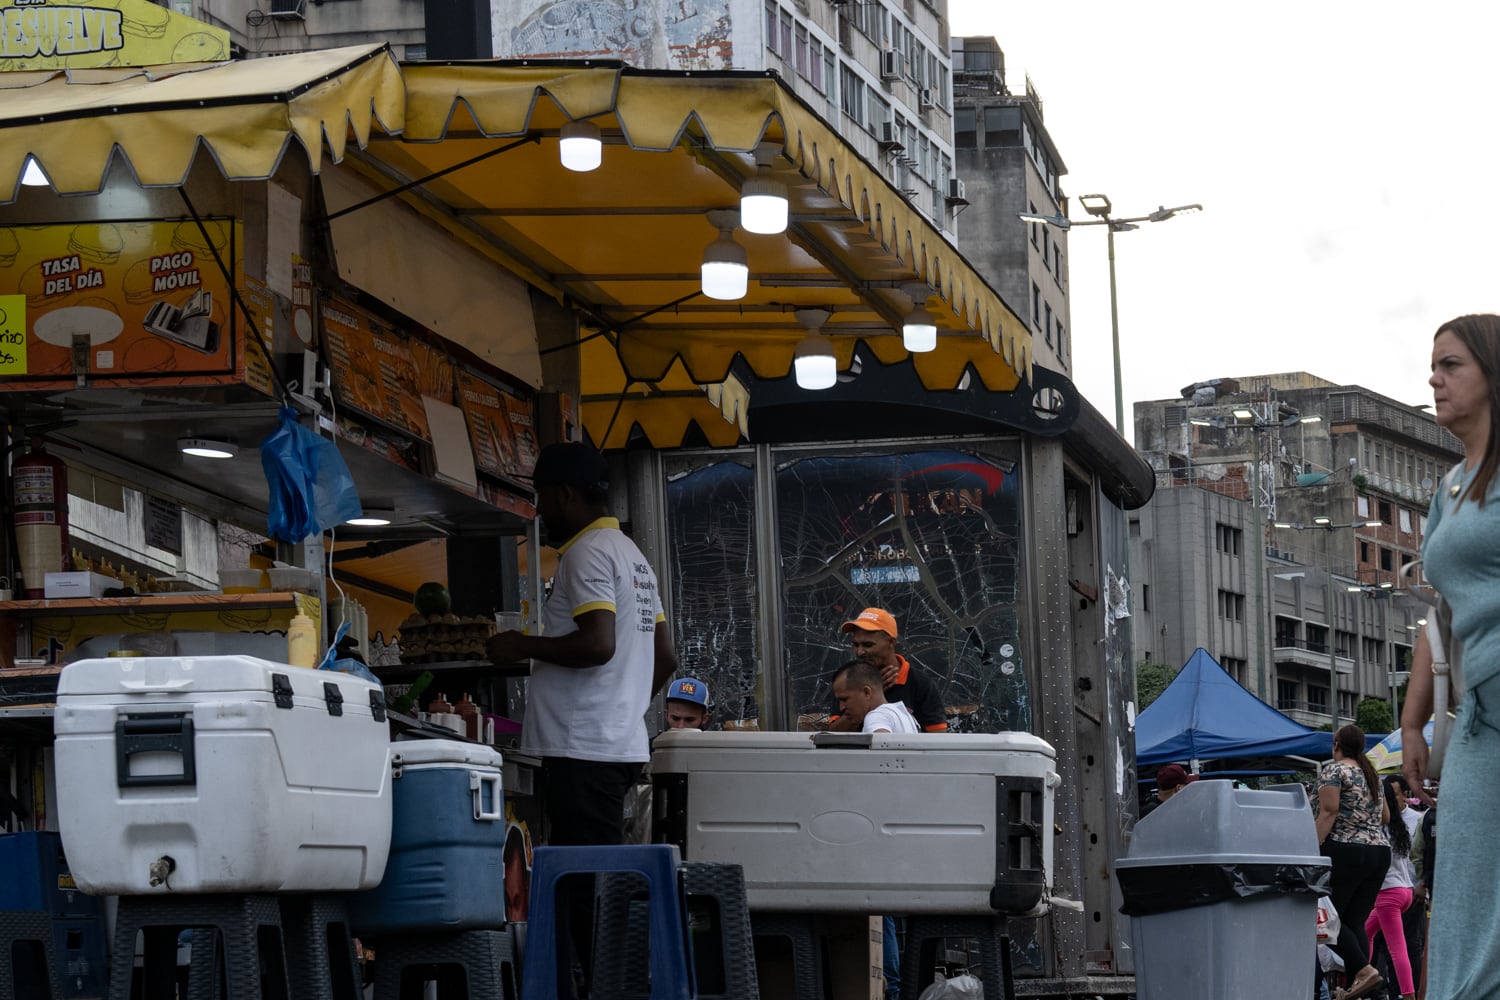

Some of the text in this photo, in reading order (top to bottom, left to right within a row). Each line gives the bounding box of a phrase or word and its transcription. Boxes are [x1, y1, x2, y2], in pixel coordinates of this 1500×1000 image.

[0, 8, 122, 56] ESUELVE
[43, 256, 80, 276] TASA
[152, 252, 192, 273] PAGO
[46, 270, 103, 296] DEL DÍA
[154, 271, 200, 292] MÓVIL
